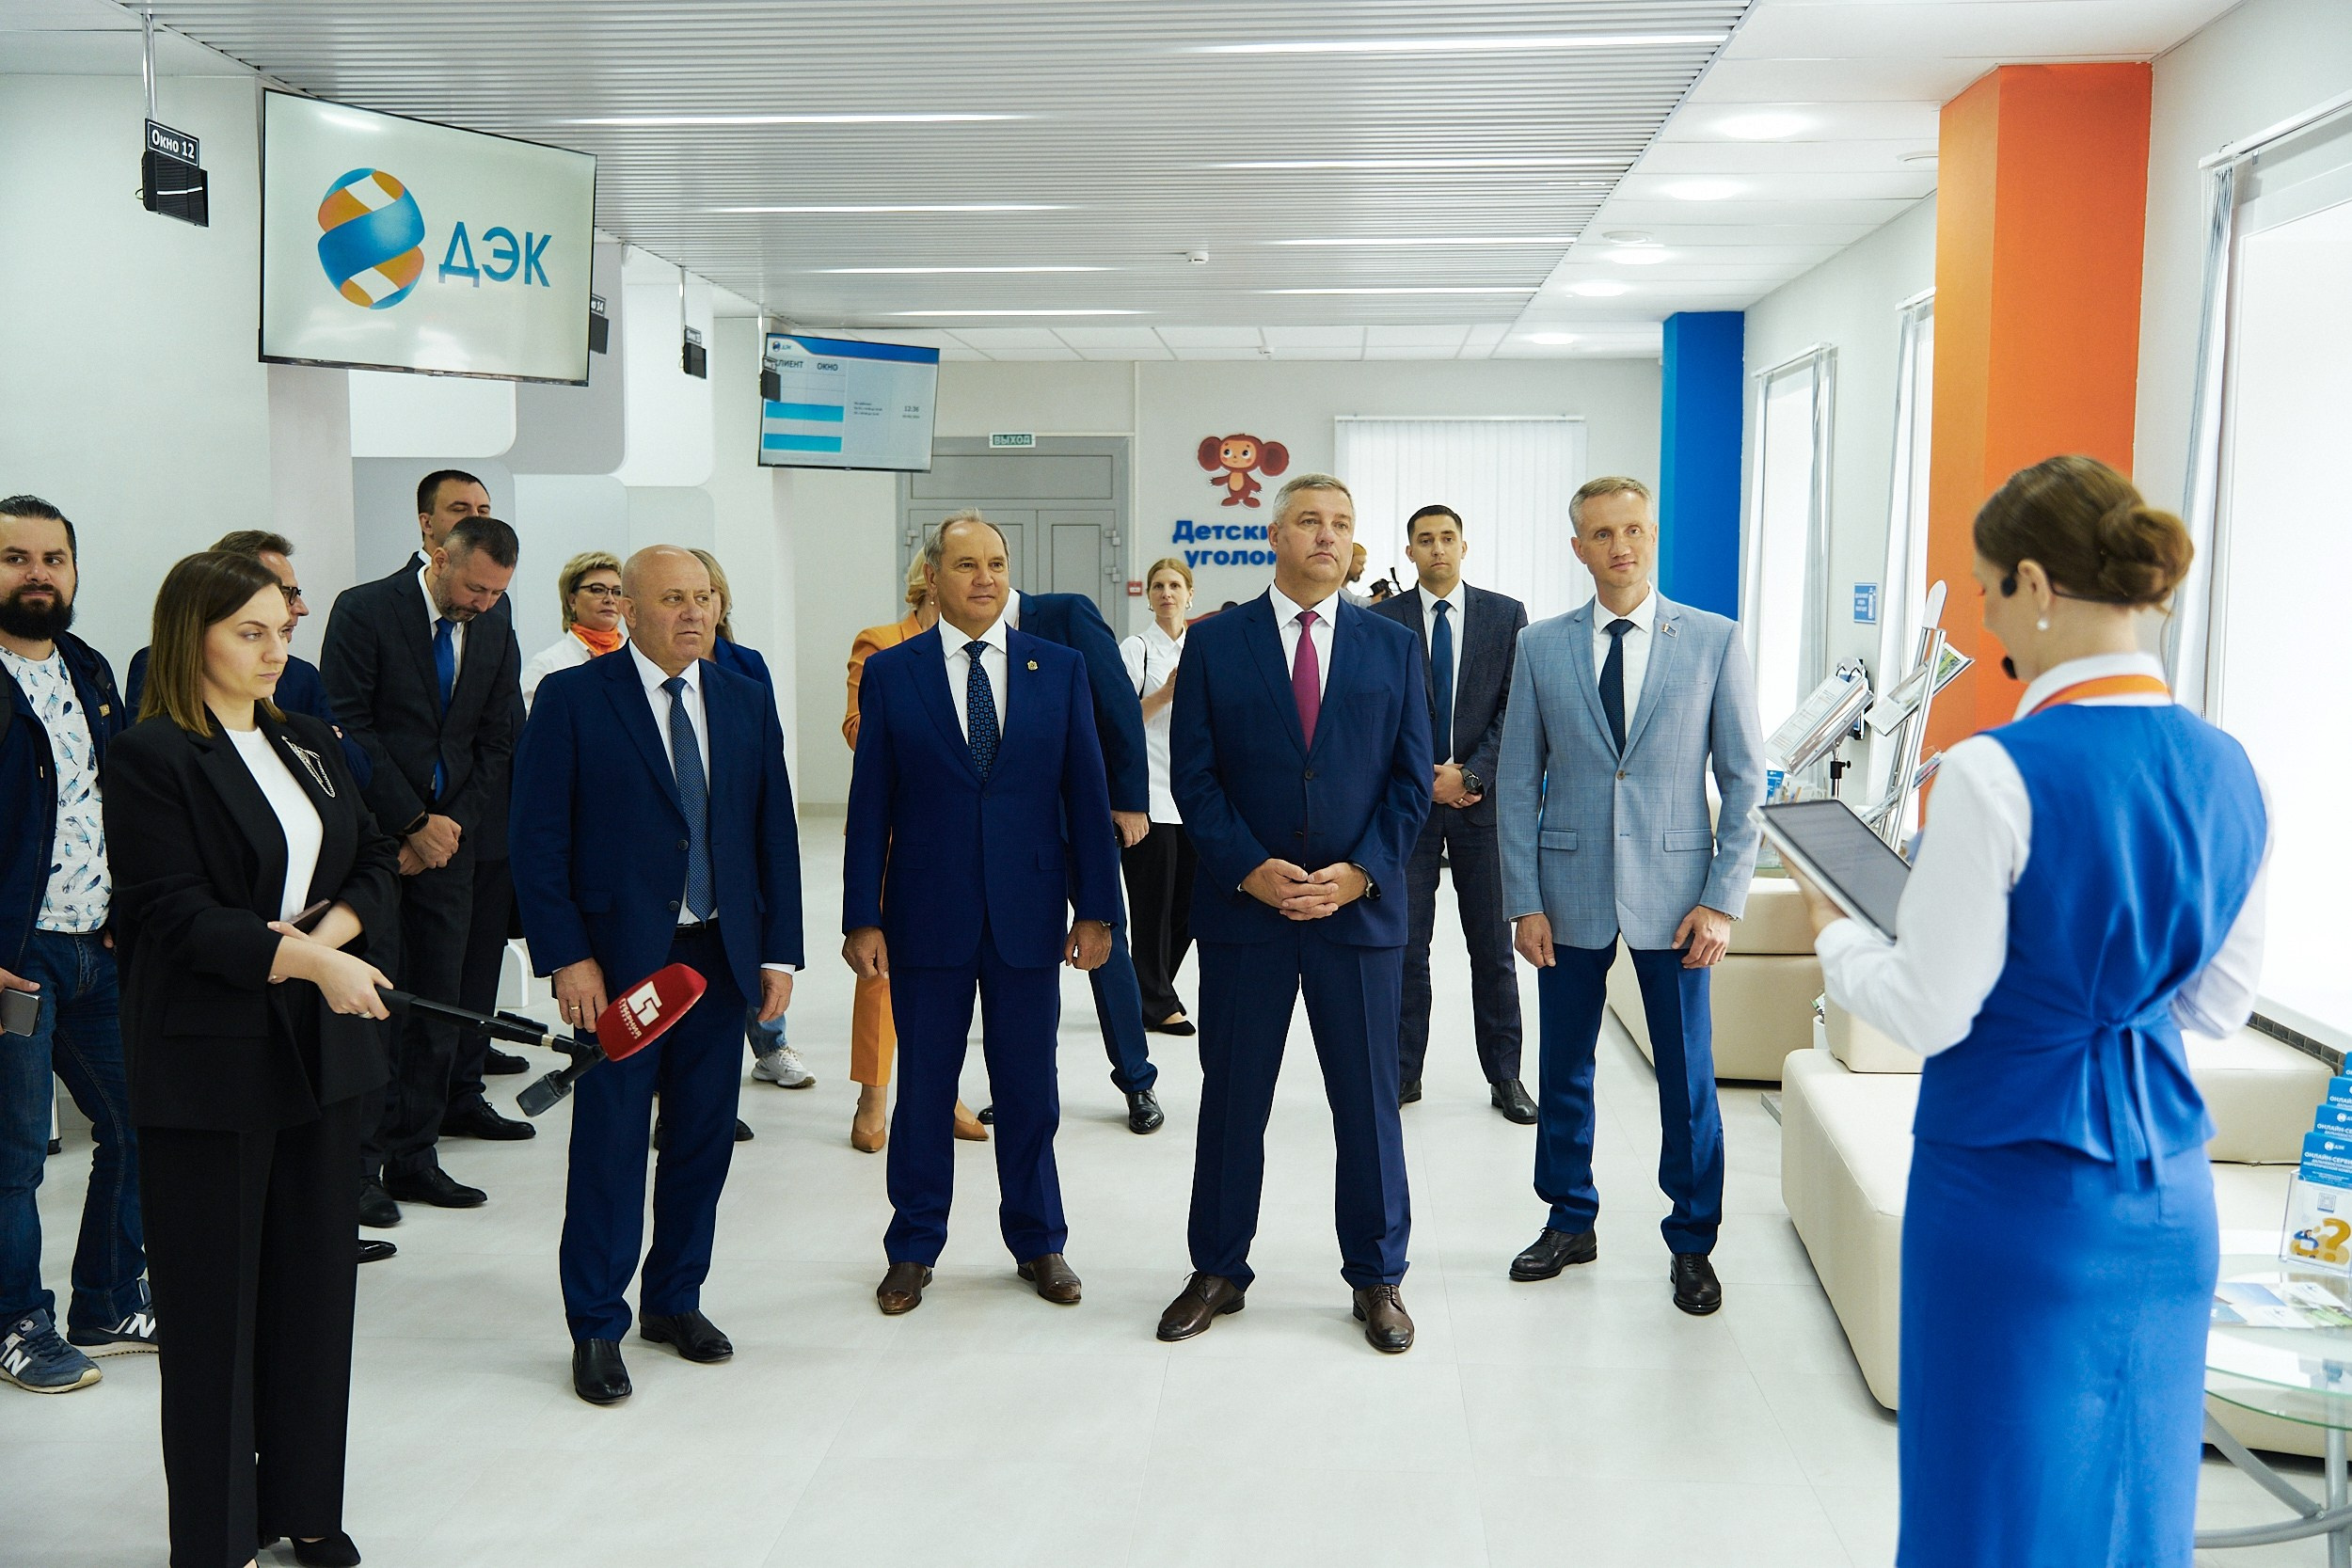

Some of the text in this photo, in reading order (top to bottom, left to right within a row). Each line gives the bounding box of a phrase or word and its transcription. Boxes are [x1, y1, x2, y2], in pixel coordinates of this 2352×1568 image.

[151, 129, 195, 159] Окно 12
[438, 221, 552, 288] ДЭК
[817, 362, 838, 372] ОКНО
[993, 435, 1031, 445] ВЫХОД
